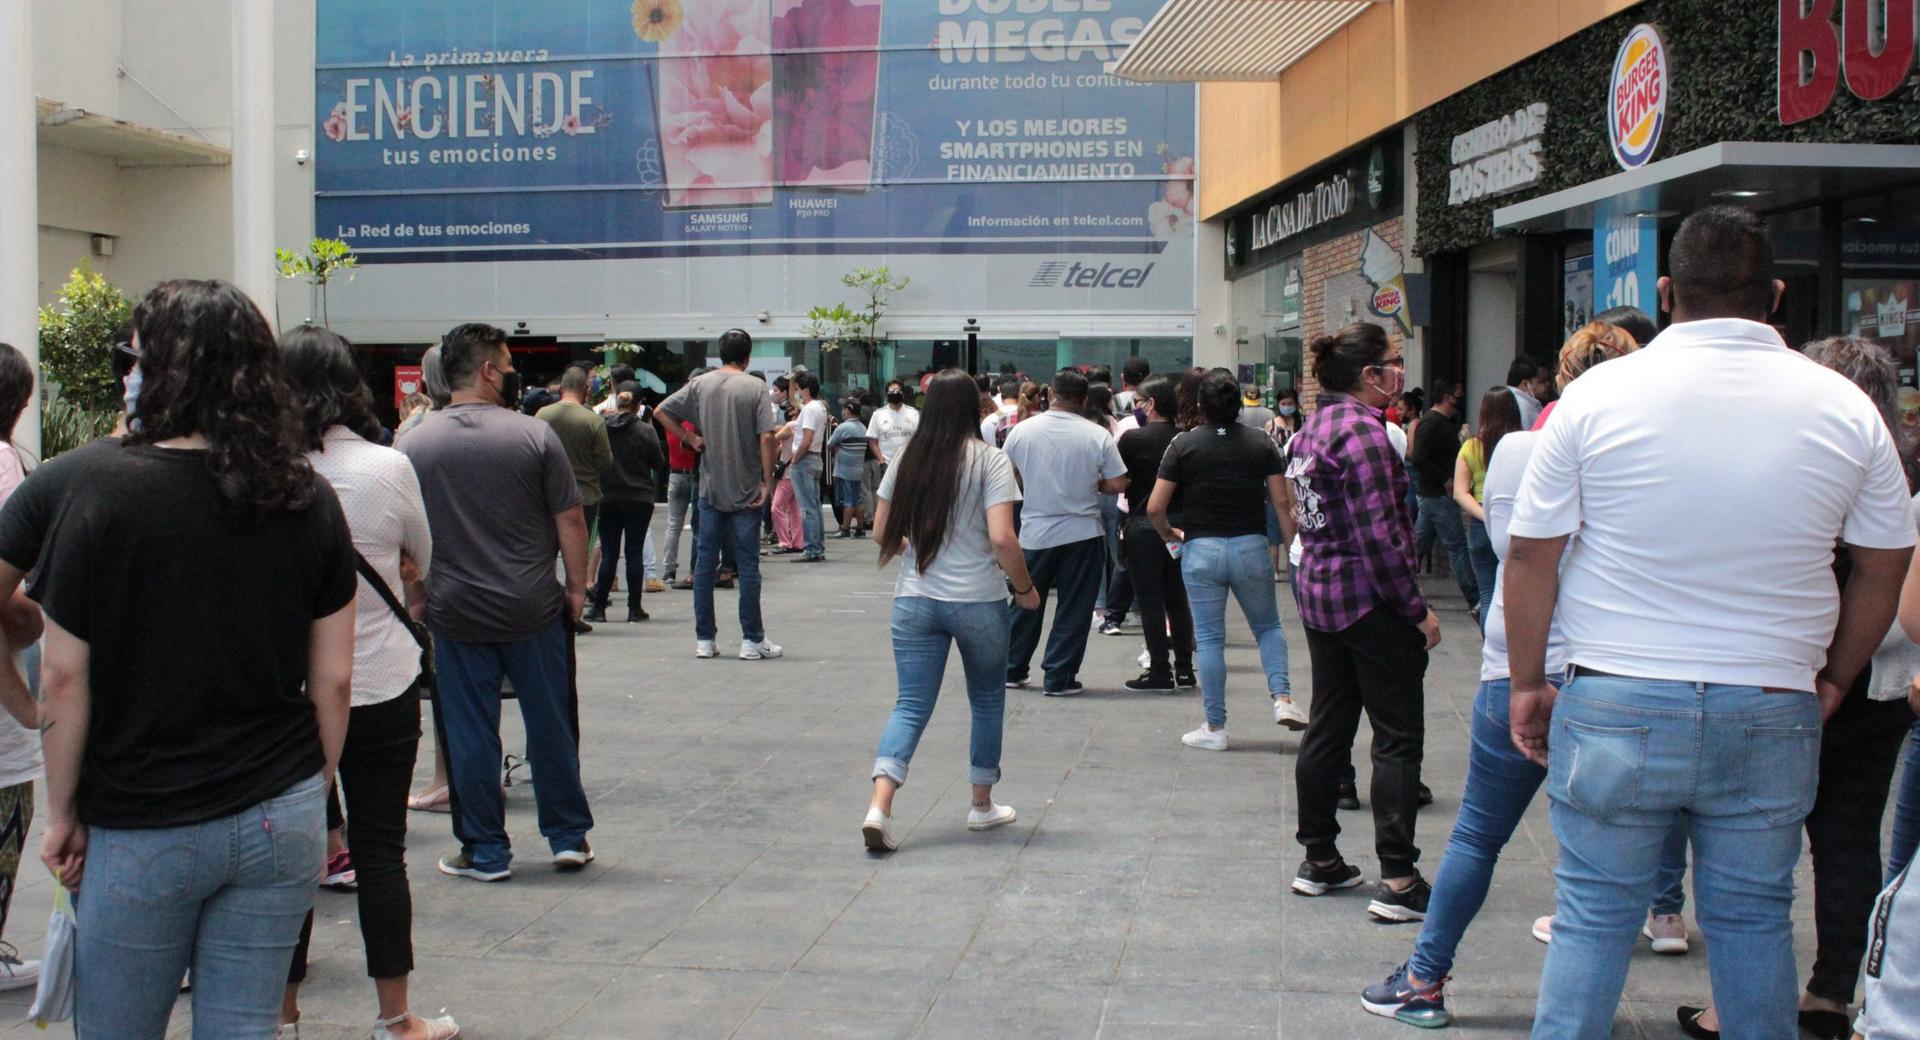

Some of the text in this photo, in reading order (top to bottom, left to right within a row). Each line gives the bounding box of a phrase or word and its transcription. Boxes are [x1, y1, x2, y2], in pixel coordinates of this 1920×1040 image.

[938, 17, 1147, 63] MEGAS
[388, 47, 549, 72] La primavera
[928, 74, 999, 91] durante
[1005, 73, 1047, 89] todo
[1051, 74, 1070, 88] tu
[1616, 46, 1659, 108] BURGER
[346, 69, 596, 141] ENCIENDE
[1618, 69, 1660, 142] KING
[956, 118, 1128, 137] Y LOS MEJORES
[1451, 102, 1548, 165] CENTRO DE
[383, 142, 557, 165] tus emociones
[940, 140, 1143, 159] SMARTPHONES EN
[947, 163, 1136, 181] FINANCIAMIENTO
[1448, 140, 1542, 205] POSTRES
[789, 199, 837, 209] HUAWEI
[1252, 214, 1267, 250] LA
[1267, 202, 1297, 244] CASA
[1297, 191, 1314, 232] DE
[1315, 175, 1349, 224] TOÑO
[690, 213, 748, 224] SAMSUNG
[968, 214, 1143, 226] Información en telcel.com
[338, 221, 530, 237] La Red de tus emociones
[685, 225, 716, 233] GALAXY
[1063, 262, 1156, 288] telcel
[1375, 290, 1400, 301] BURGER
[1376, 297, 1401, 309] KING
